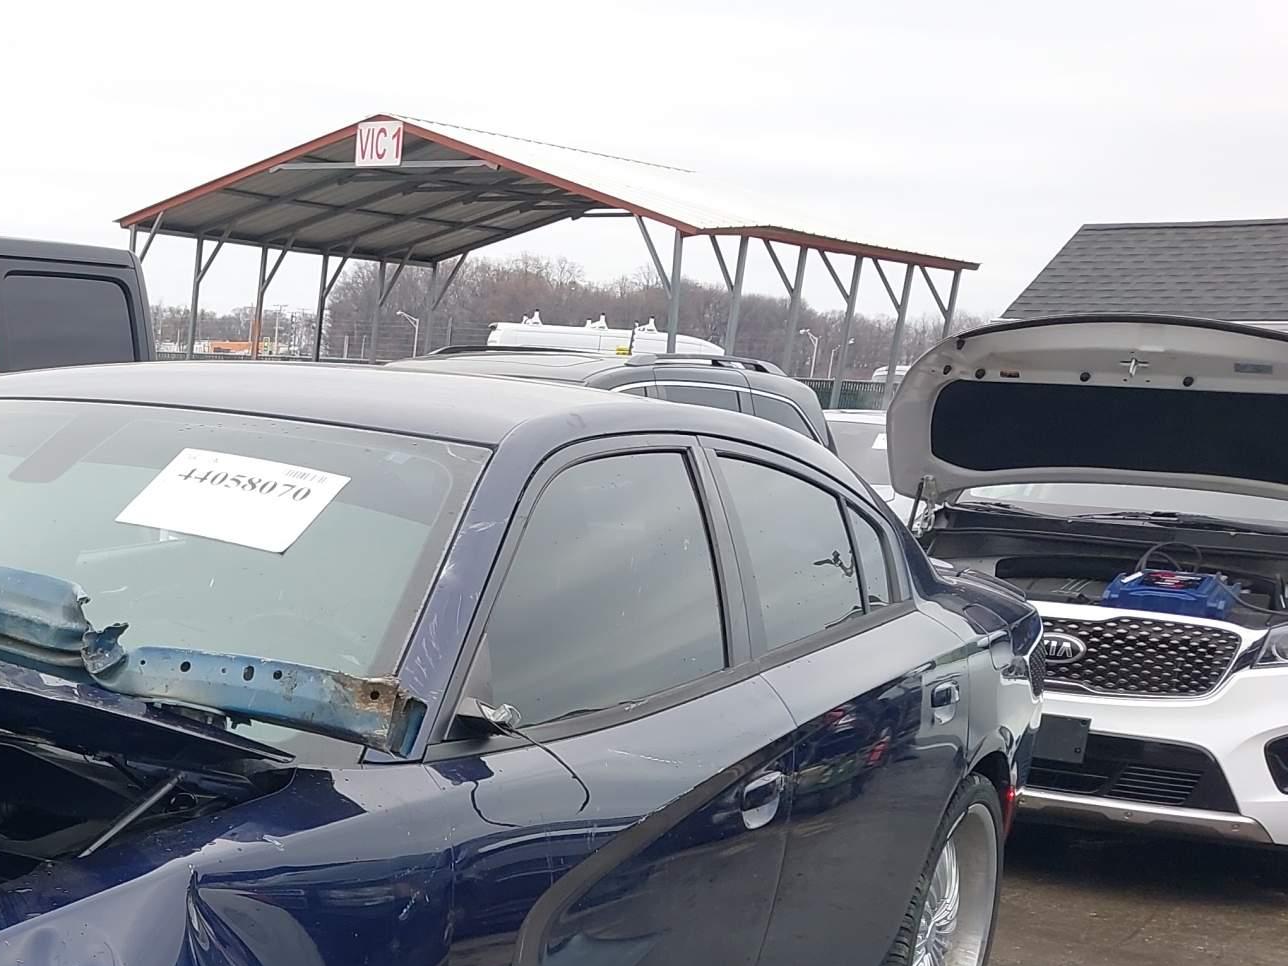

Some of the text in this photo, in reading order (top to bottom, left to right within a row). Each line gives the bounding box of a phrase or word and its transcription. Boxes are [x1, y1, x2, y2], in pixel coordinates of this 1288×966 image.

[359, 126, 401, 160] VIC 1
[177, 467, 312, 502] 44058070
